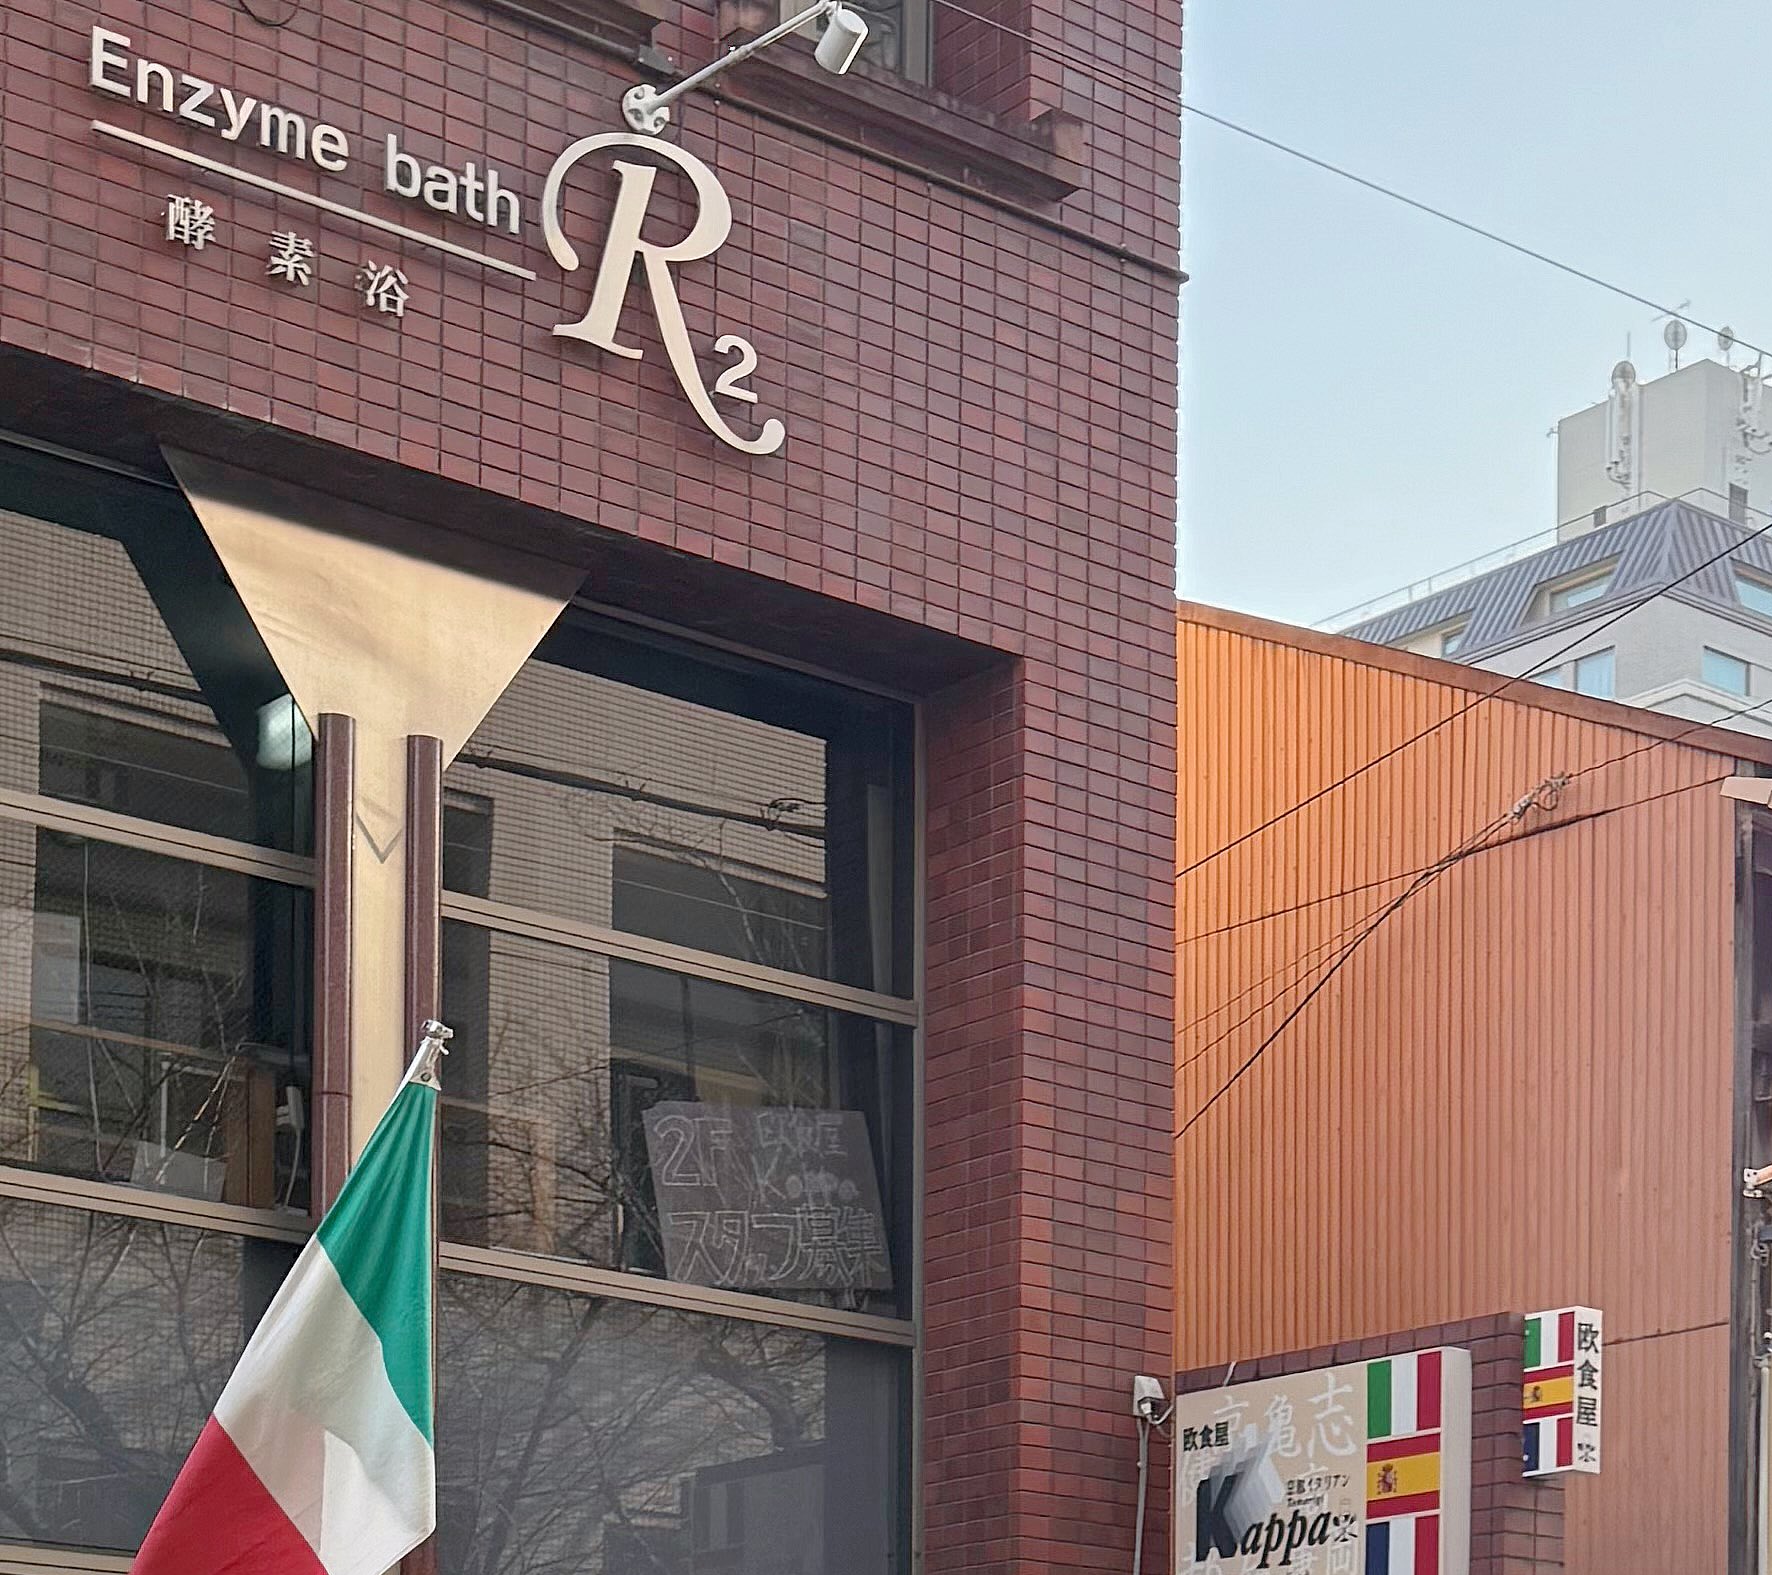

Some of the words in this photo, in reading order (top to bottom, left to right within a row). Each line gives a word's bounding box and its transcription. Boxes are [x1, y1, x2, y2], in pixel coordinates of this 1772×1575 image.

[90, 26, 350, 173] Enzyme
[385, 135, 521, 235] bath
[163, 195, 410, 318] 酵素浴
[1576, 1322, 1599, 1428] 欧食屋
[1195, 1475, 1332, 1569] Kappa
